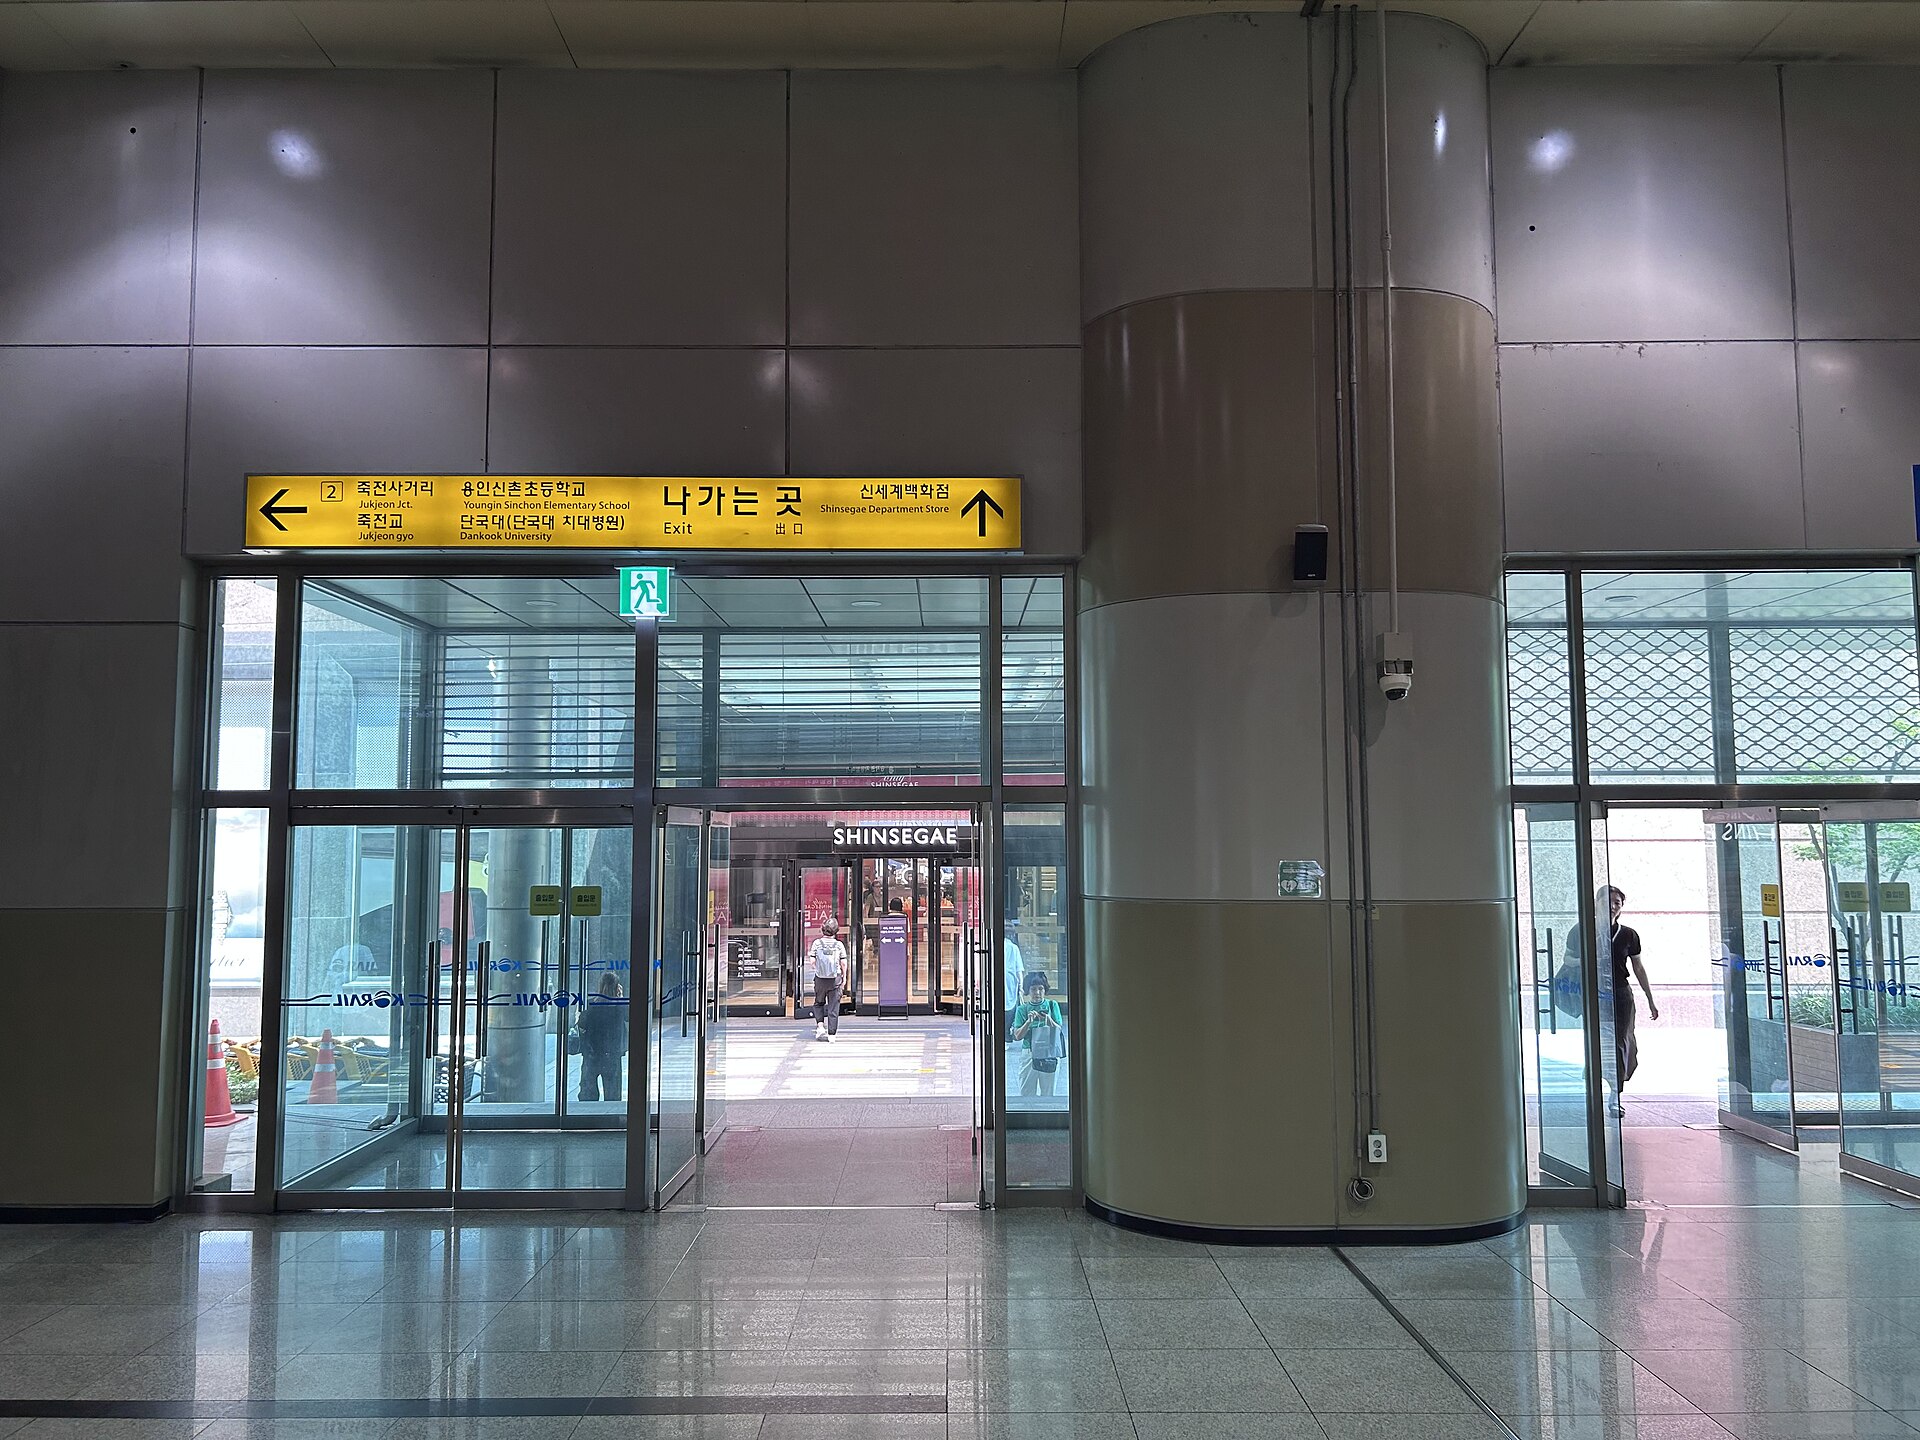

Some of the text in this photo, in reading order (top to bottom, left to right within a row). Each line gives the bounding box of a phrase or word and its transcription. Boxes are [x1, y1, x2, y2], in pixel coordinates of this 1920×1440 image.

[326, 484, 337, 499] 2
[357, 481, 434, 497] 죽전사거리
[461, 481, 586, 498] 용인신촌초등학교
[860, 484, 949, 499] 신세계백화점
[358, 500, 413, 511] Jukjeon Jct.
[464, 500, 630, 512] Youngin Sinchon Elementary School
[663, 486, 802, 517] 나가는 곳
[820, 504, 950, 516] Shinsegae Department Store
[357, 513, 403, 530] 죽전교
[460, 514, 625, 532] 단국대(단국대 치대병원)
[663, 522, 693, 535] Exit
[358, 531, 415, 543] Jukjeon gyo
[460, 531, 552, 543] Dankook University
[833, 828, 957, 845] SHINSEGAE
